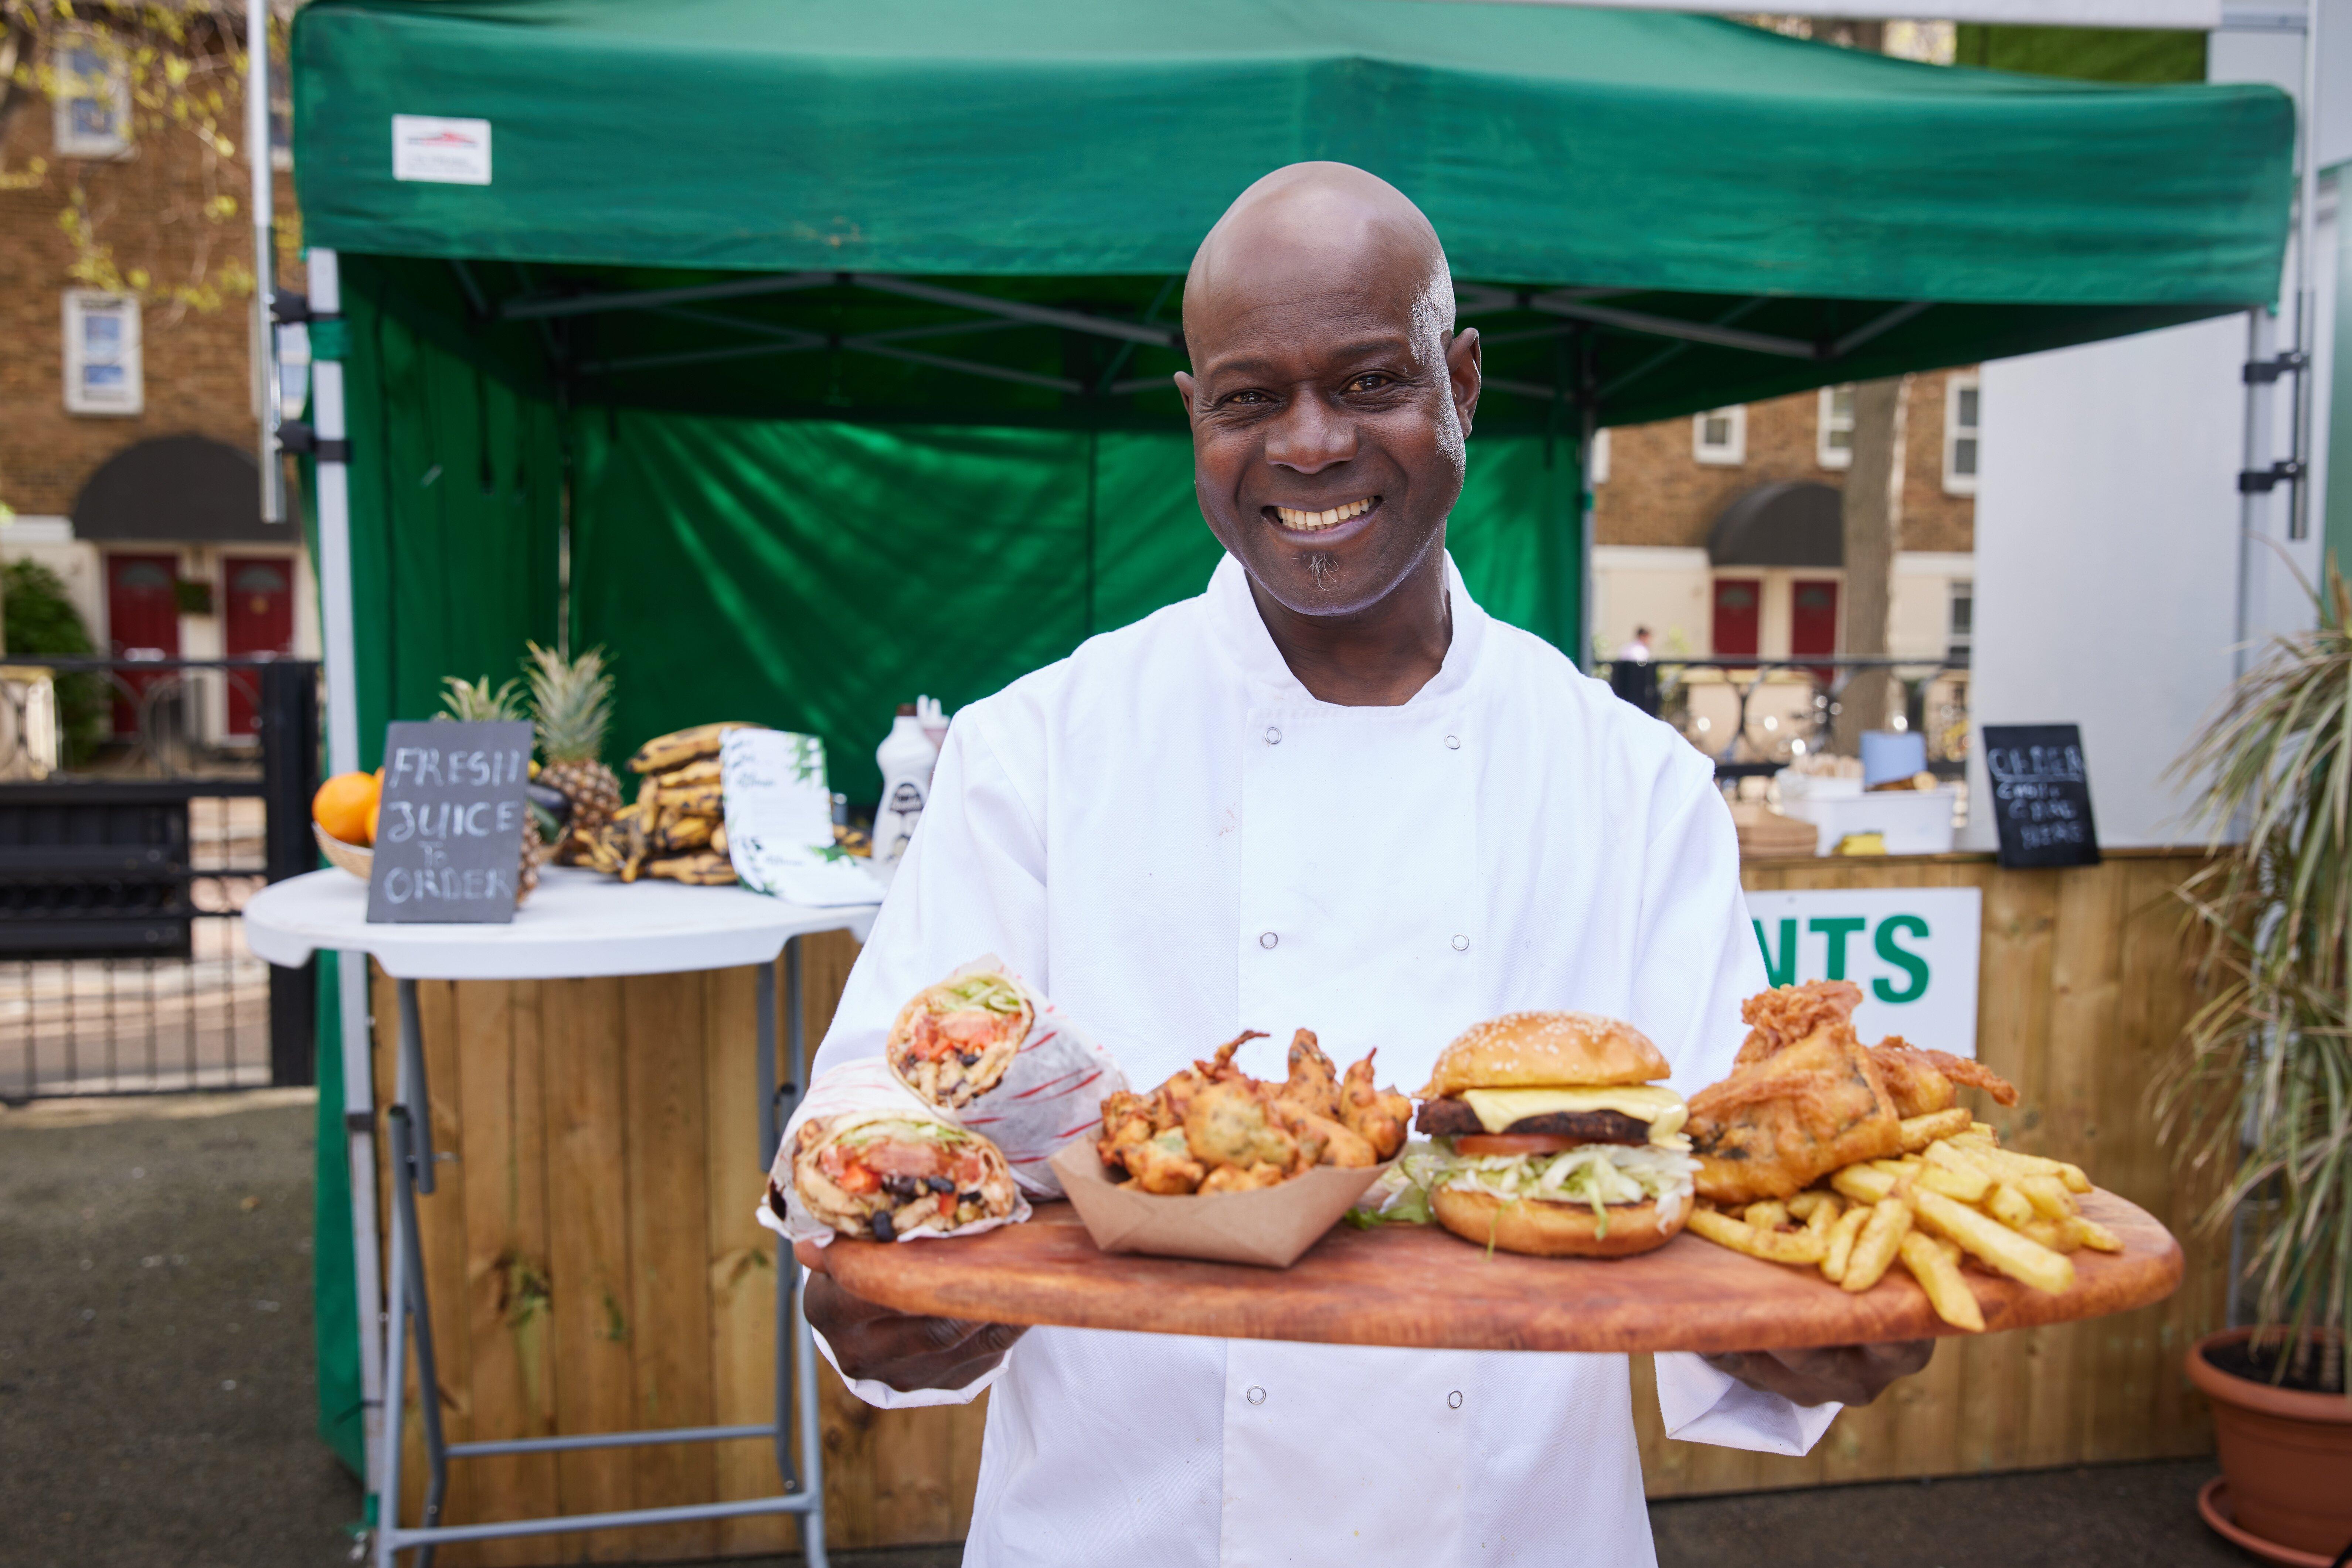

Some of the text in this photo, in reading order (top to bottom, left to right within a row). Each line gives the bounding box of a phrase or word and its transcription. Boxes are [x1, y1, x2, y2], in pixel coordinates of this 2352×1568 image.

[389, 747, 520, 788] FRESH
[387, 801, 519, 842] JUICE
[383, 866, 513, 904] ORDER
